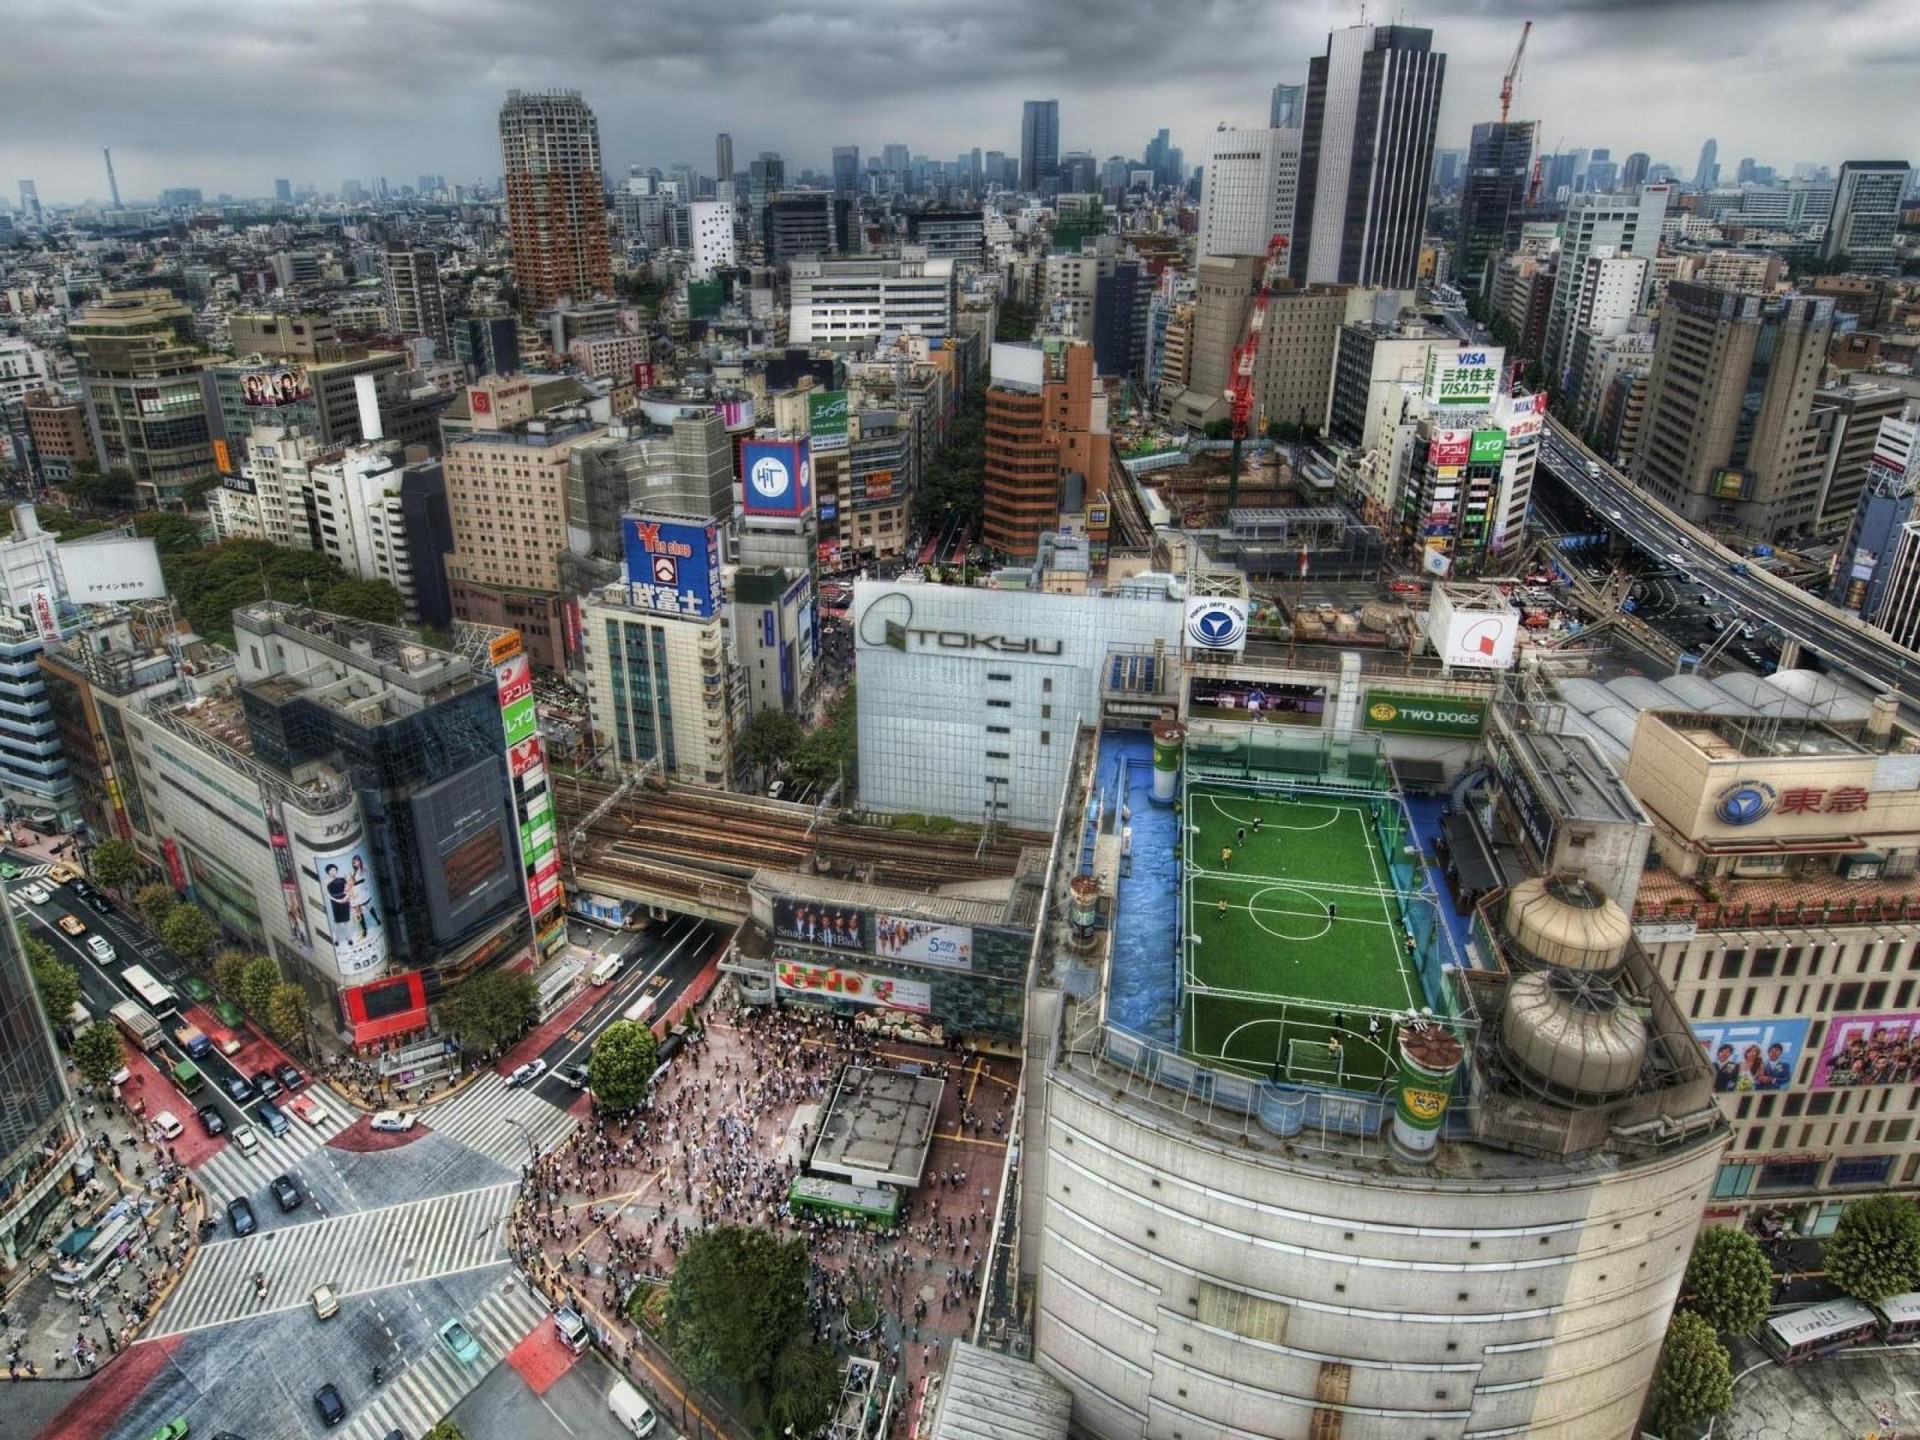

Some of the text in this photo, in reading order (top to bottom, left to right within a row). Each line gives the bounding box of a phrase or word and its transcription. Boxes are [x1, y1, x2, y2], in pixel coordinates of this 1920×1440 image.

[1458, 353, 1486, 365] VISA
[1442, 367, 1497, 382] 三井住友
[1441, 382, 1495, 395] VISAカード
[1440, 445, 1467, 455] アコム
[1475, 440, 1503, 451] レイク
[631, 581, 703, 616] 武富士
[907, 629, 1063, 655] TOKYU
[502, 682, 533, 703] アコム
[506, 709, 534, 733] レイク
[1398, 708, 1480, 725] TWO DOGS
[513, 755, 540, 776] アイフル
[1776, 787, 1869, 815] 東急
[326, 821, 350, 837] 109
